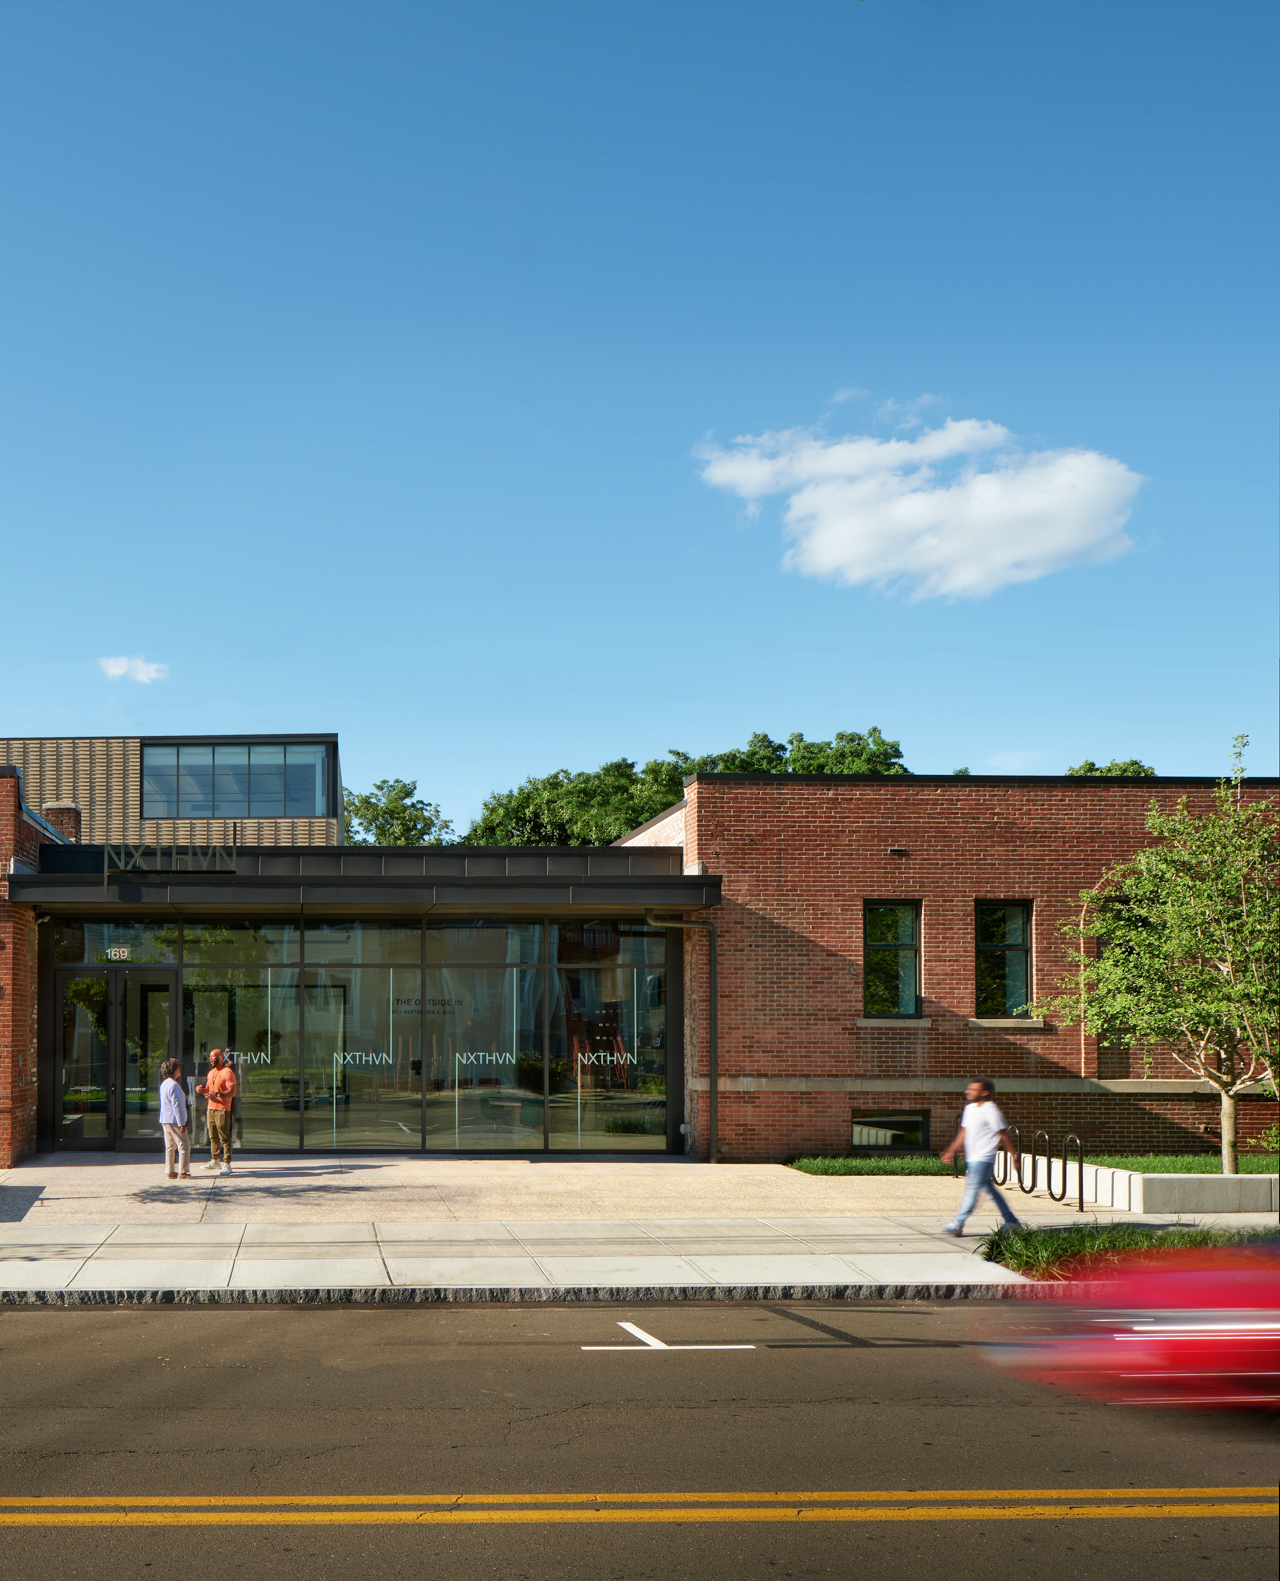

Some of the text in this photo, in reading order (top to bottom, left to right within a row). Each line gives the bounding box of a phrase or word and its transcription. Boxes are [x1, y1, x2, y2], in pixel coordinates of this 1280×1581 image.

[104, 844, 237, 872] NXTHVN
[105, 948, 128, 960] 169
[333, 1052, 393, 1065] NXTHVN
[455, 1052, 516, 1065] NXTHVN
[578, 1052, 637, 1065] NXTHVN
